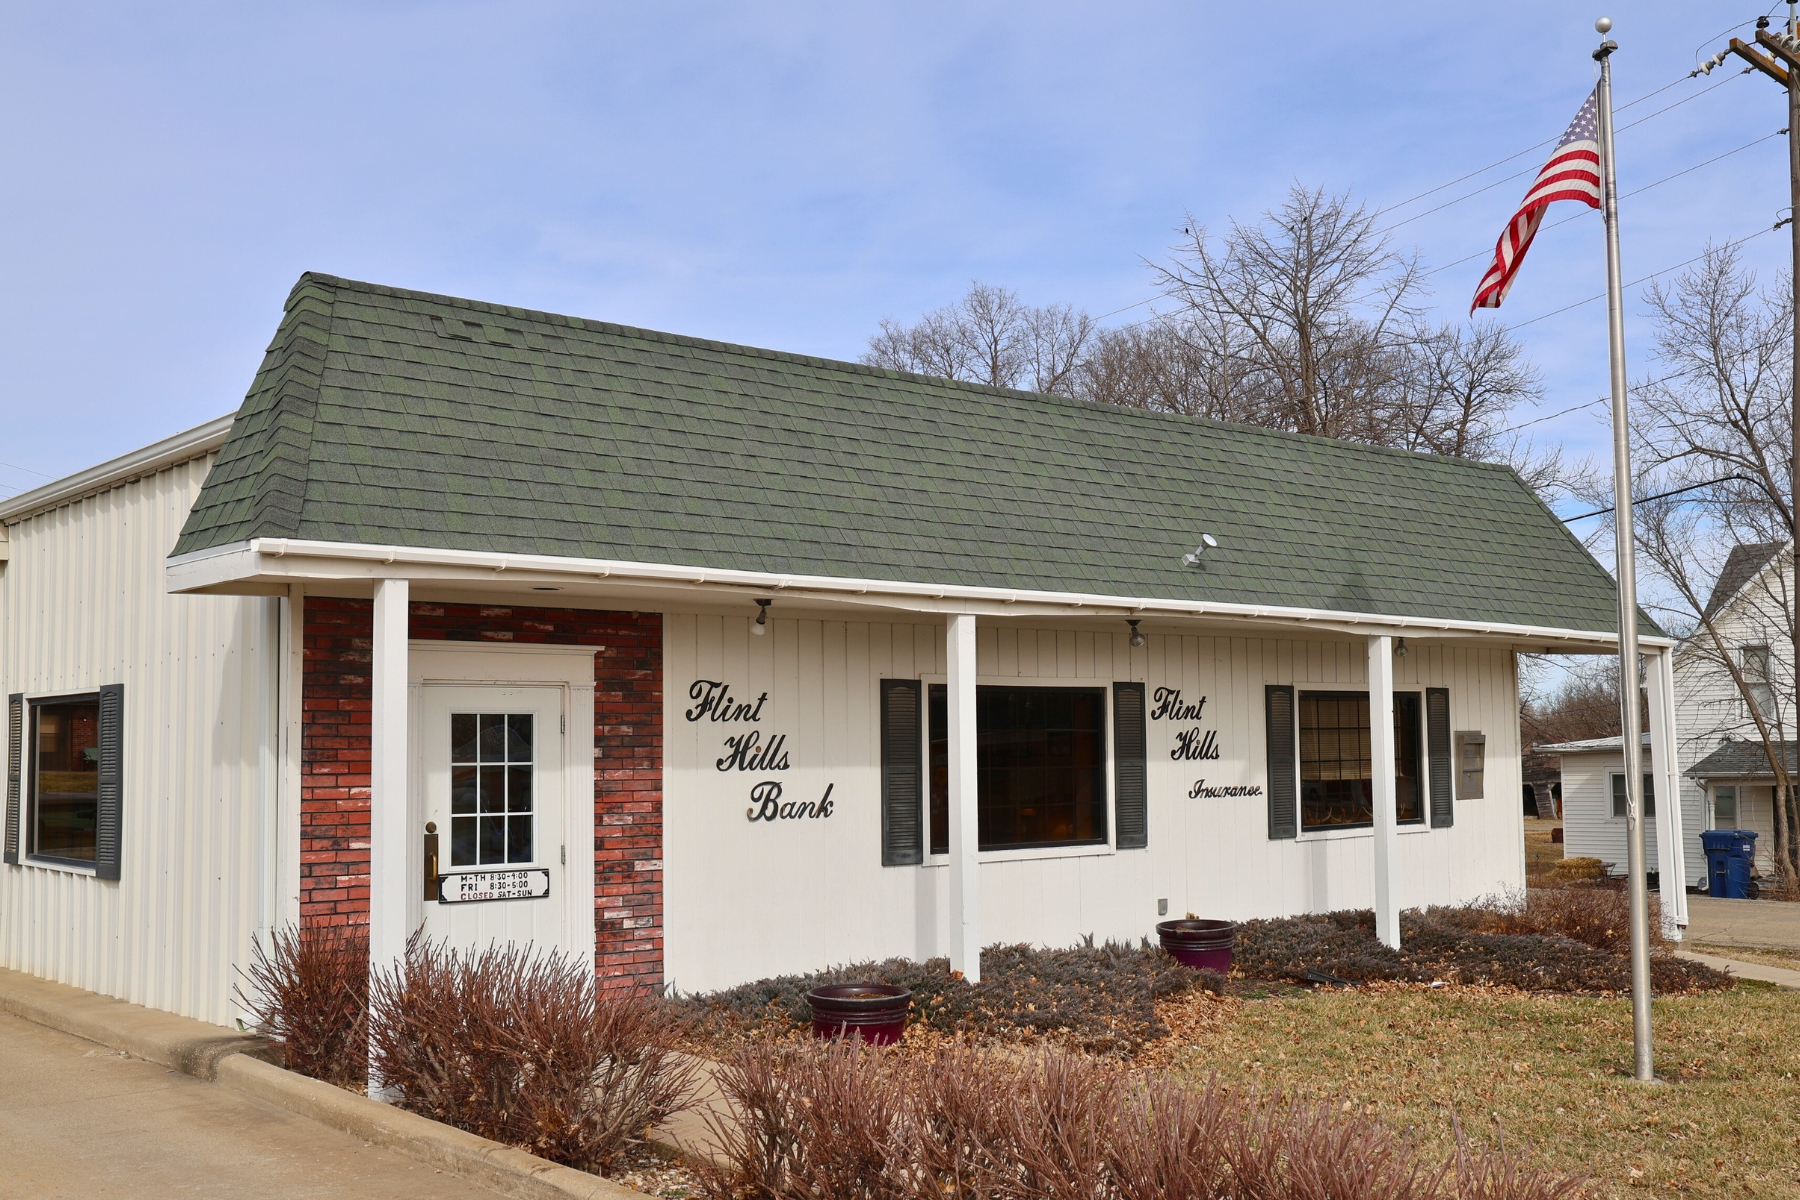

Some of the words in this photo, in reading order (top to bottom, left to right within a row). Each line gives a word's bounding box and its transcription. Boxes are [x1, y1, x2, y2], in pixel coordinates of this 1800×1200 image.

[685, 679, 768, 722] Flint
[1151, 686, 1206, 720] Flint
[716, 730, 790, 772] Hills
[1171, 727, 1220, 760] Hills
[747, 781, 834, 822] Bank
[1188, 779, 1263, 799] Insurance
[460, 874, 486, 882] M-TH
[489, 871, 529, 881] 8:30-4:00
[460, 883, 478, 892] FRI
[460, 891, 494, 900] CLOSED
[497, 889, 533, 898] SAT-SUN
